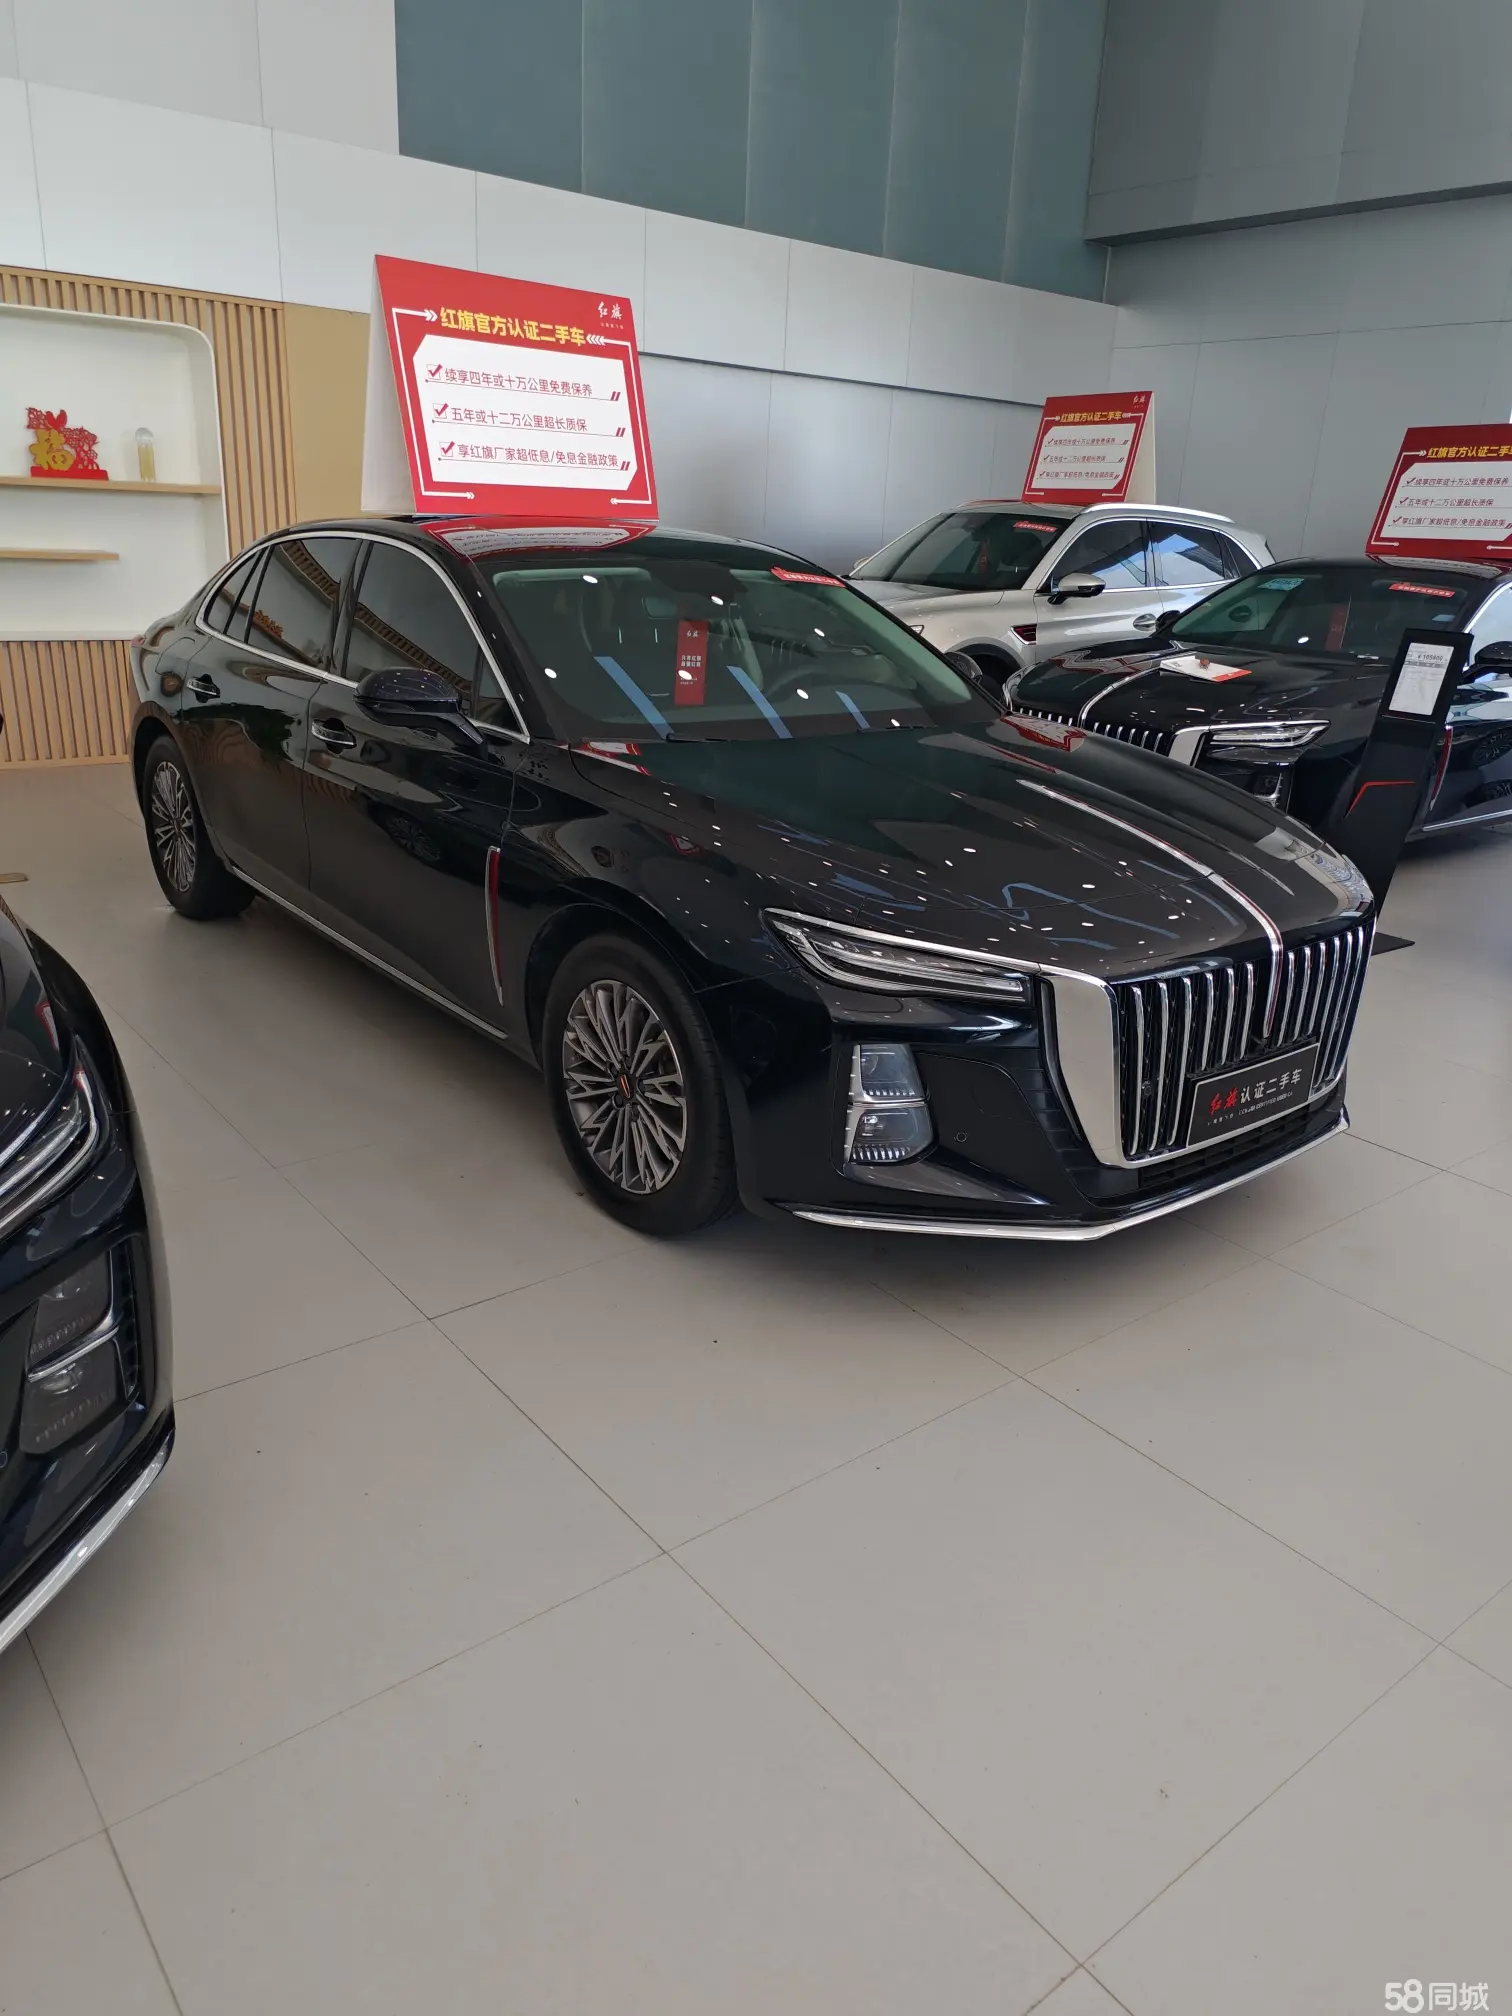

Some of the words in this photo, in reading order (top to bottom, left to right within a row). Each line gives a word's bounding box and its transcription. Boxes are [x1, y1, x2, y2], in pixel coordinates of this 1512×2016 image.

[598, 301, 622, 320] 红旗
[440, 306, 586, 346] 红旗官方认证二手车
[444, 368, 593, 397] 续享四年或十万公里免费保养
[451, 407, 588, 432] 五年或十二万公里超长质保
[457, 443, 619, 467] 享红旗厂家超低息/免息金融政策
